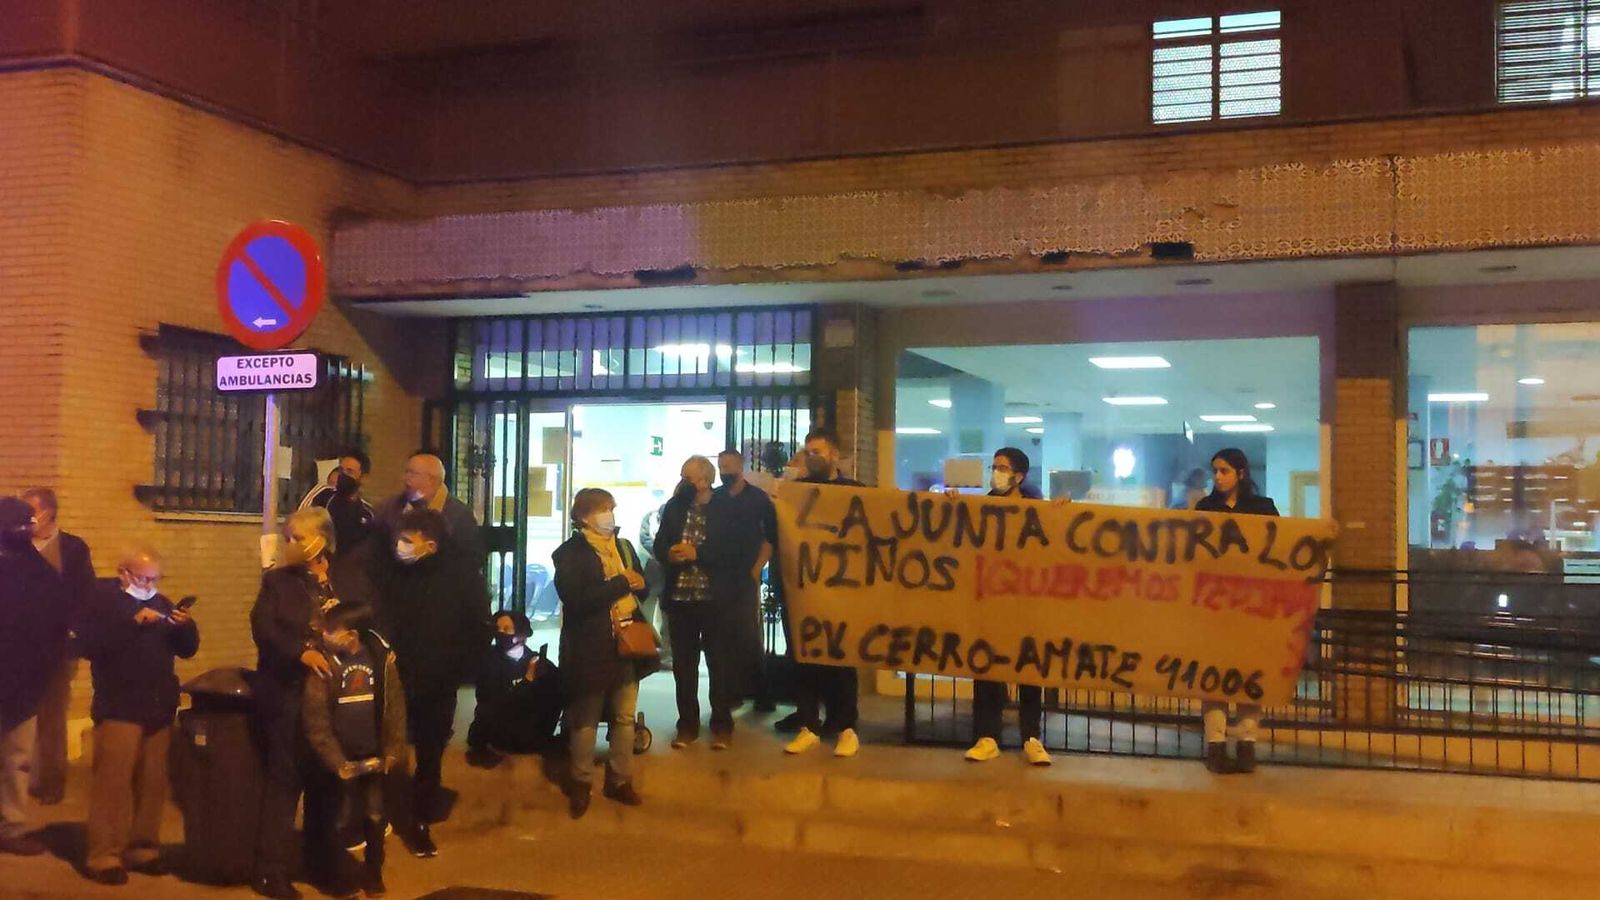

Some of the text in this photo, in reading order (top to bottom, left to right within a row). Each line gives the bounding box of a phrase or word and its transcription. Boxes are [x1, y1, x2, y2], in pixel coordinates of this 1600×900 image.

[219, 373, 313, 386] AMBULANCIAS
[236, 356, 295, 369] EXCEPTO
[796, 487, 875, 541] LA
[890, 491, 1050, 551] JUNTA
[1065, 511, 1249, 565] CONTRA
[858, 624, 1142, 689] CERRO-AMATE
[1155, 654, 1265, 700] 41006
